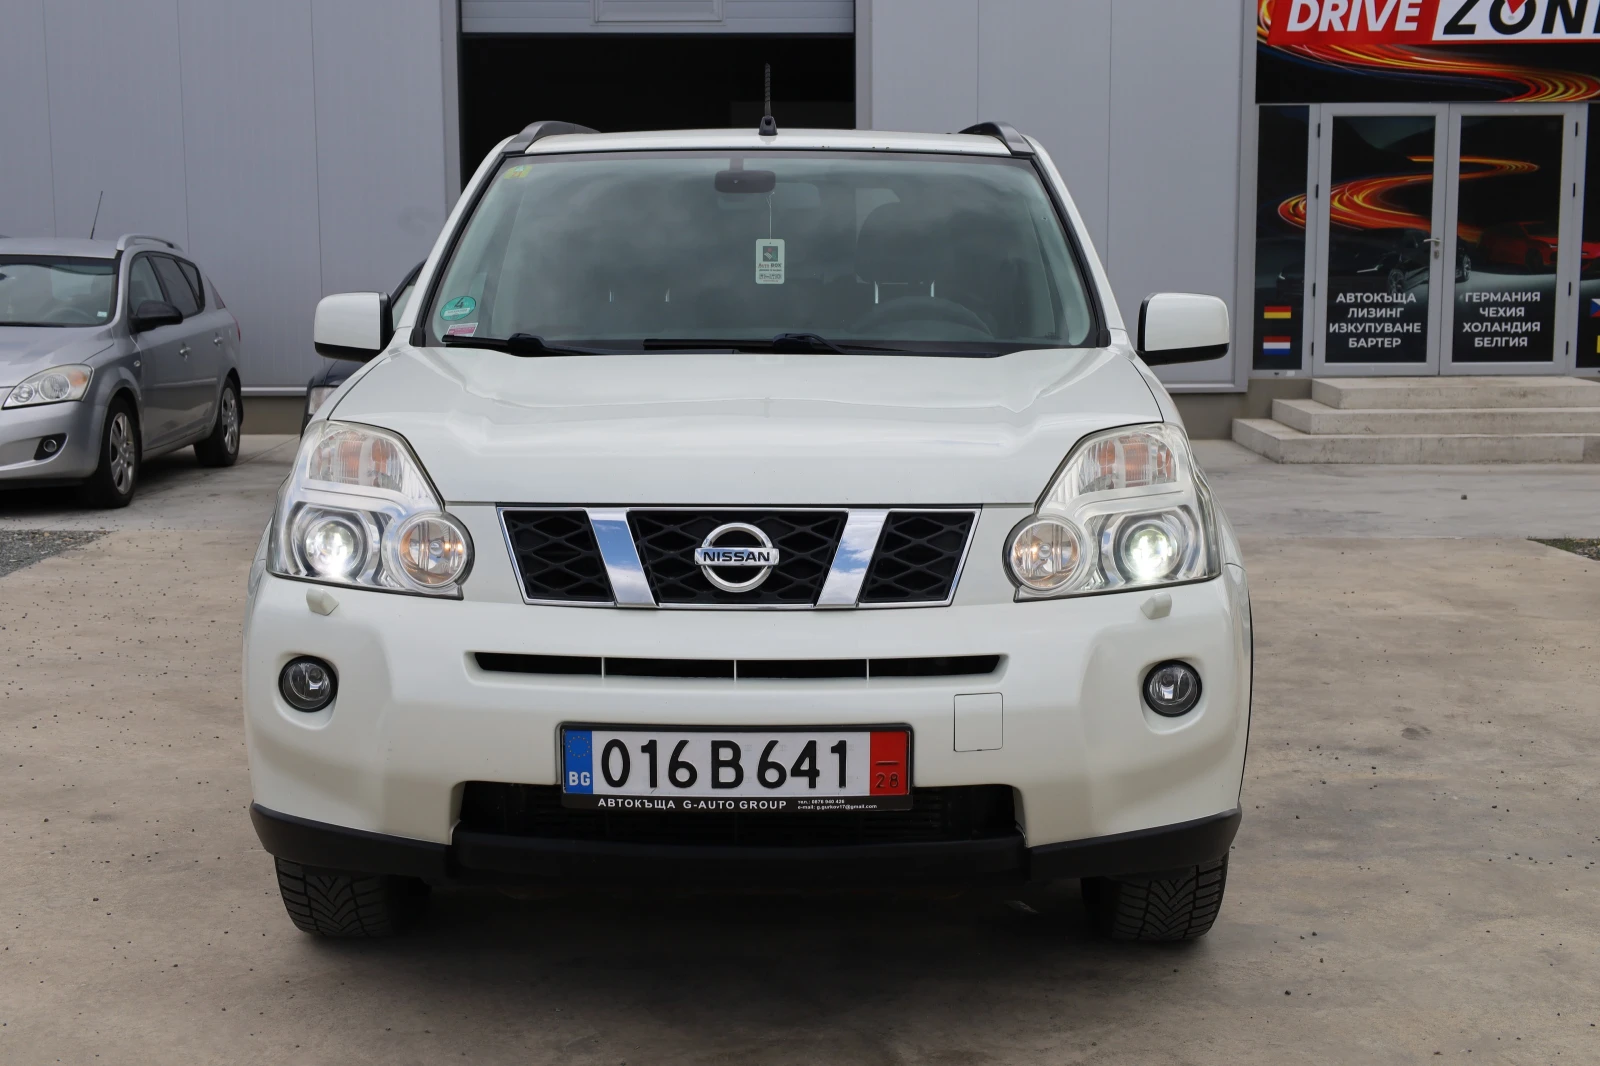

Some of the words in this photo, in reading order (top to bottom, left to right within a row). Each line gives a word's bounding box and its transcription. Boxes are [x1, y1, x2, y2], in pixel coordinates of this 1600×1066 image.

[1286, 0, 1422, 32] DRIVE
[1442, 0, 1600, 36] ZON
[1335, 292, 1417, 304] АВТОКЪЩА
[1465, 291, 1541, 303] ГЕРМАНИЯ
[1347, 307, 1404, 318] ЛИЗИНГ
[1479, 306, 1525, 317] ЧЕХИЯ
[1329, 322, 1422, 333] ИЗКУПУВАНЕ
[1462, 321, 1541, 333] ХОЛАНДИЯ
[1348, 338, 1402, 348] БАРТЕР
[1474, 336, 1528, 348] БЕЛГИЯ
[703, 551, 770, 562] NISSAN
[568, 771, 591, 786] BG
[875, 771, 899, 788] 28
[598, 798, 676, 810] АВТОКЪЩА
[682, 800, 735, 810] G-AUTO
[739, 800, 787, 810] GROUP
